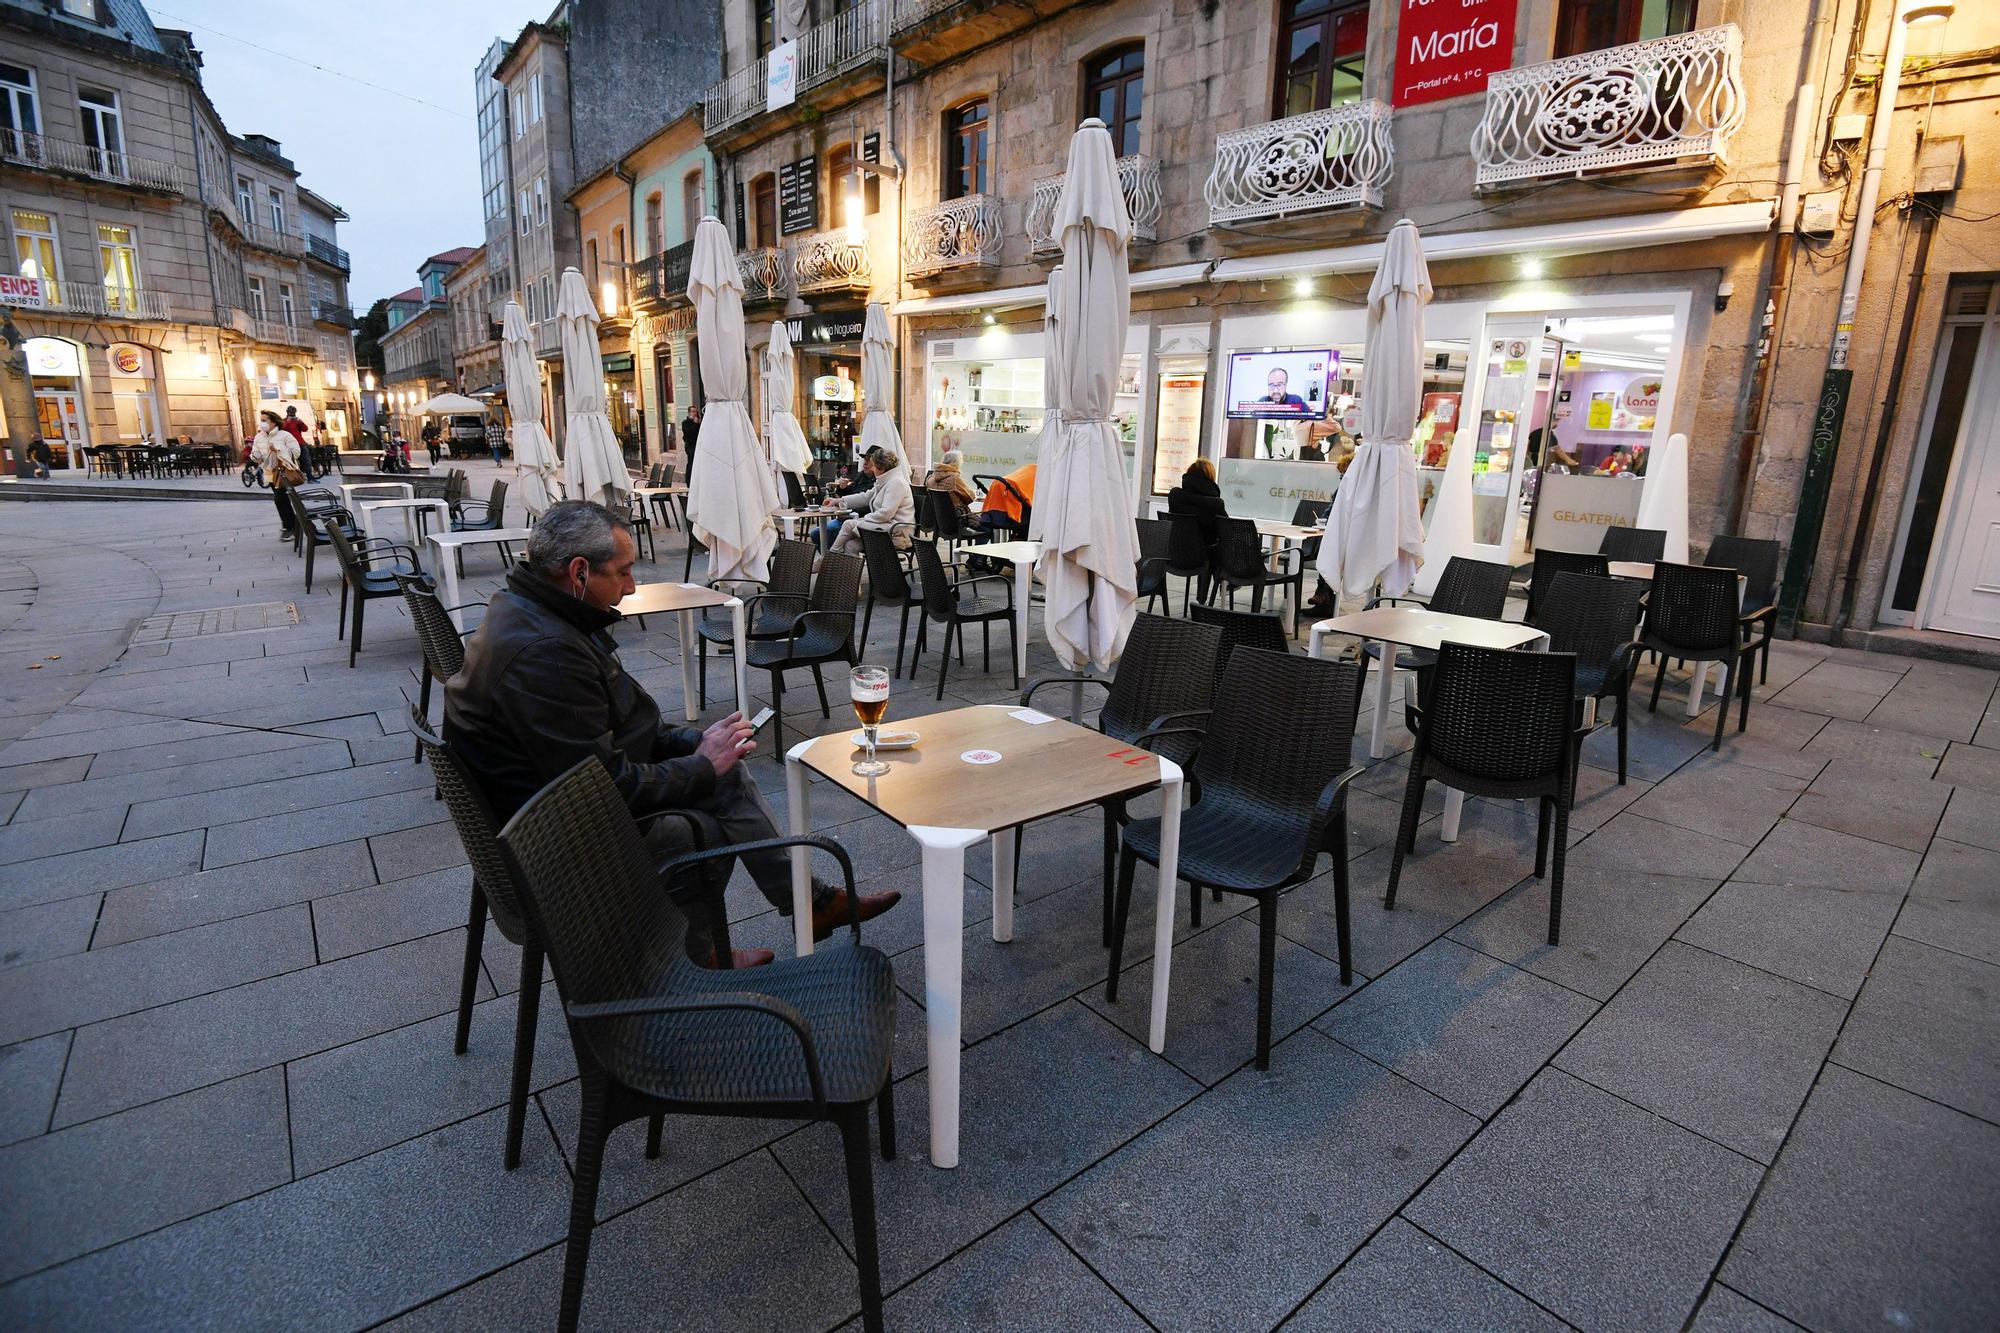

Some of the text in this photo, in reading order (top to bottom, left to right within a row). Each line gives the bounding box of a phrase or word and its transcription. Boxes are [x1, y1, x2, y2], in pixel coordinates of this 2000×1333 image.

[1410, 17, 1498, 65] María
[1418, 68, 1482, 90] Portal nº 4, 1º C
[1626, 395, 1658, 407] Lana
[1269, 486, 1326, 501] GELATERÍA
[1553, 510, 1627, 528] GELATERÍA
